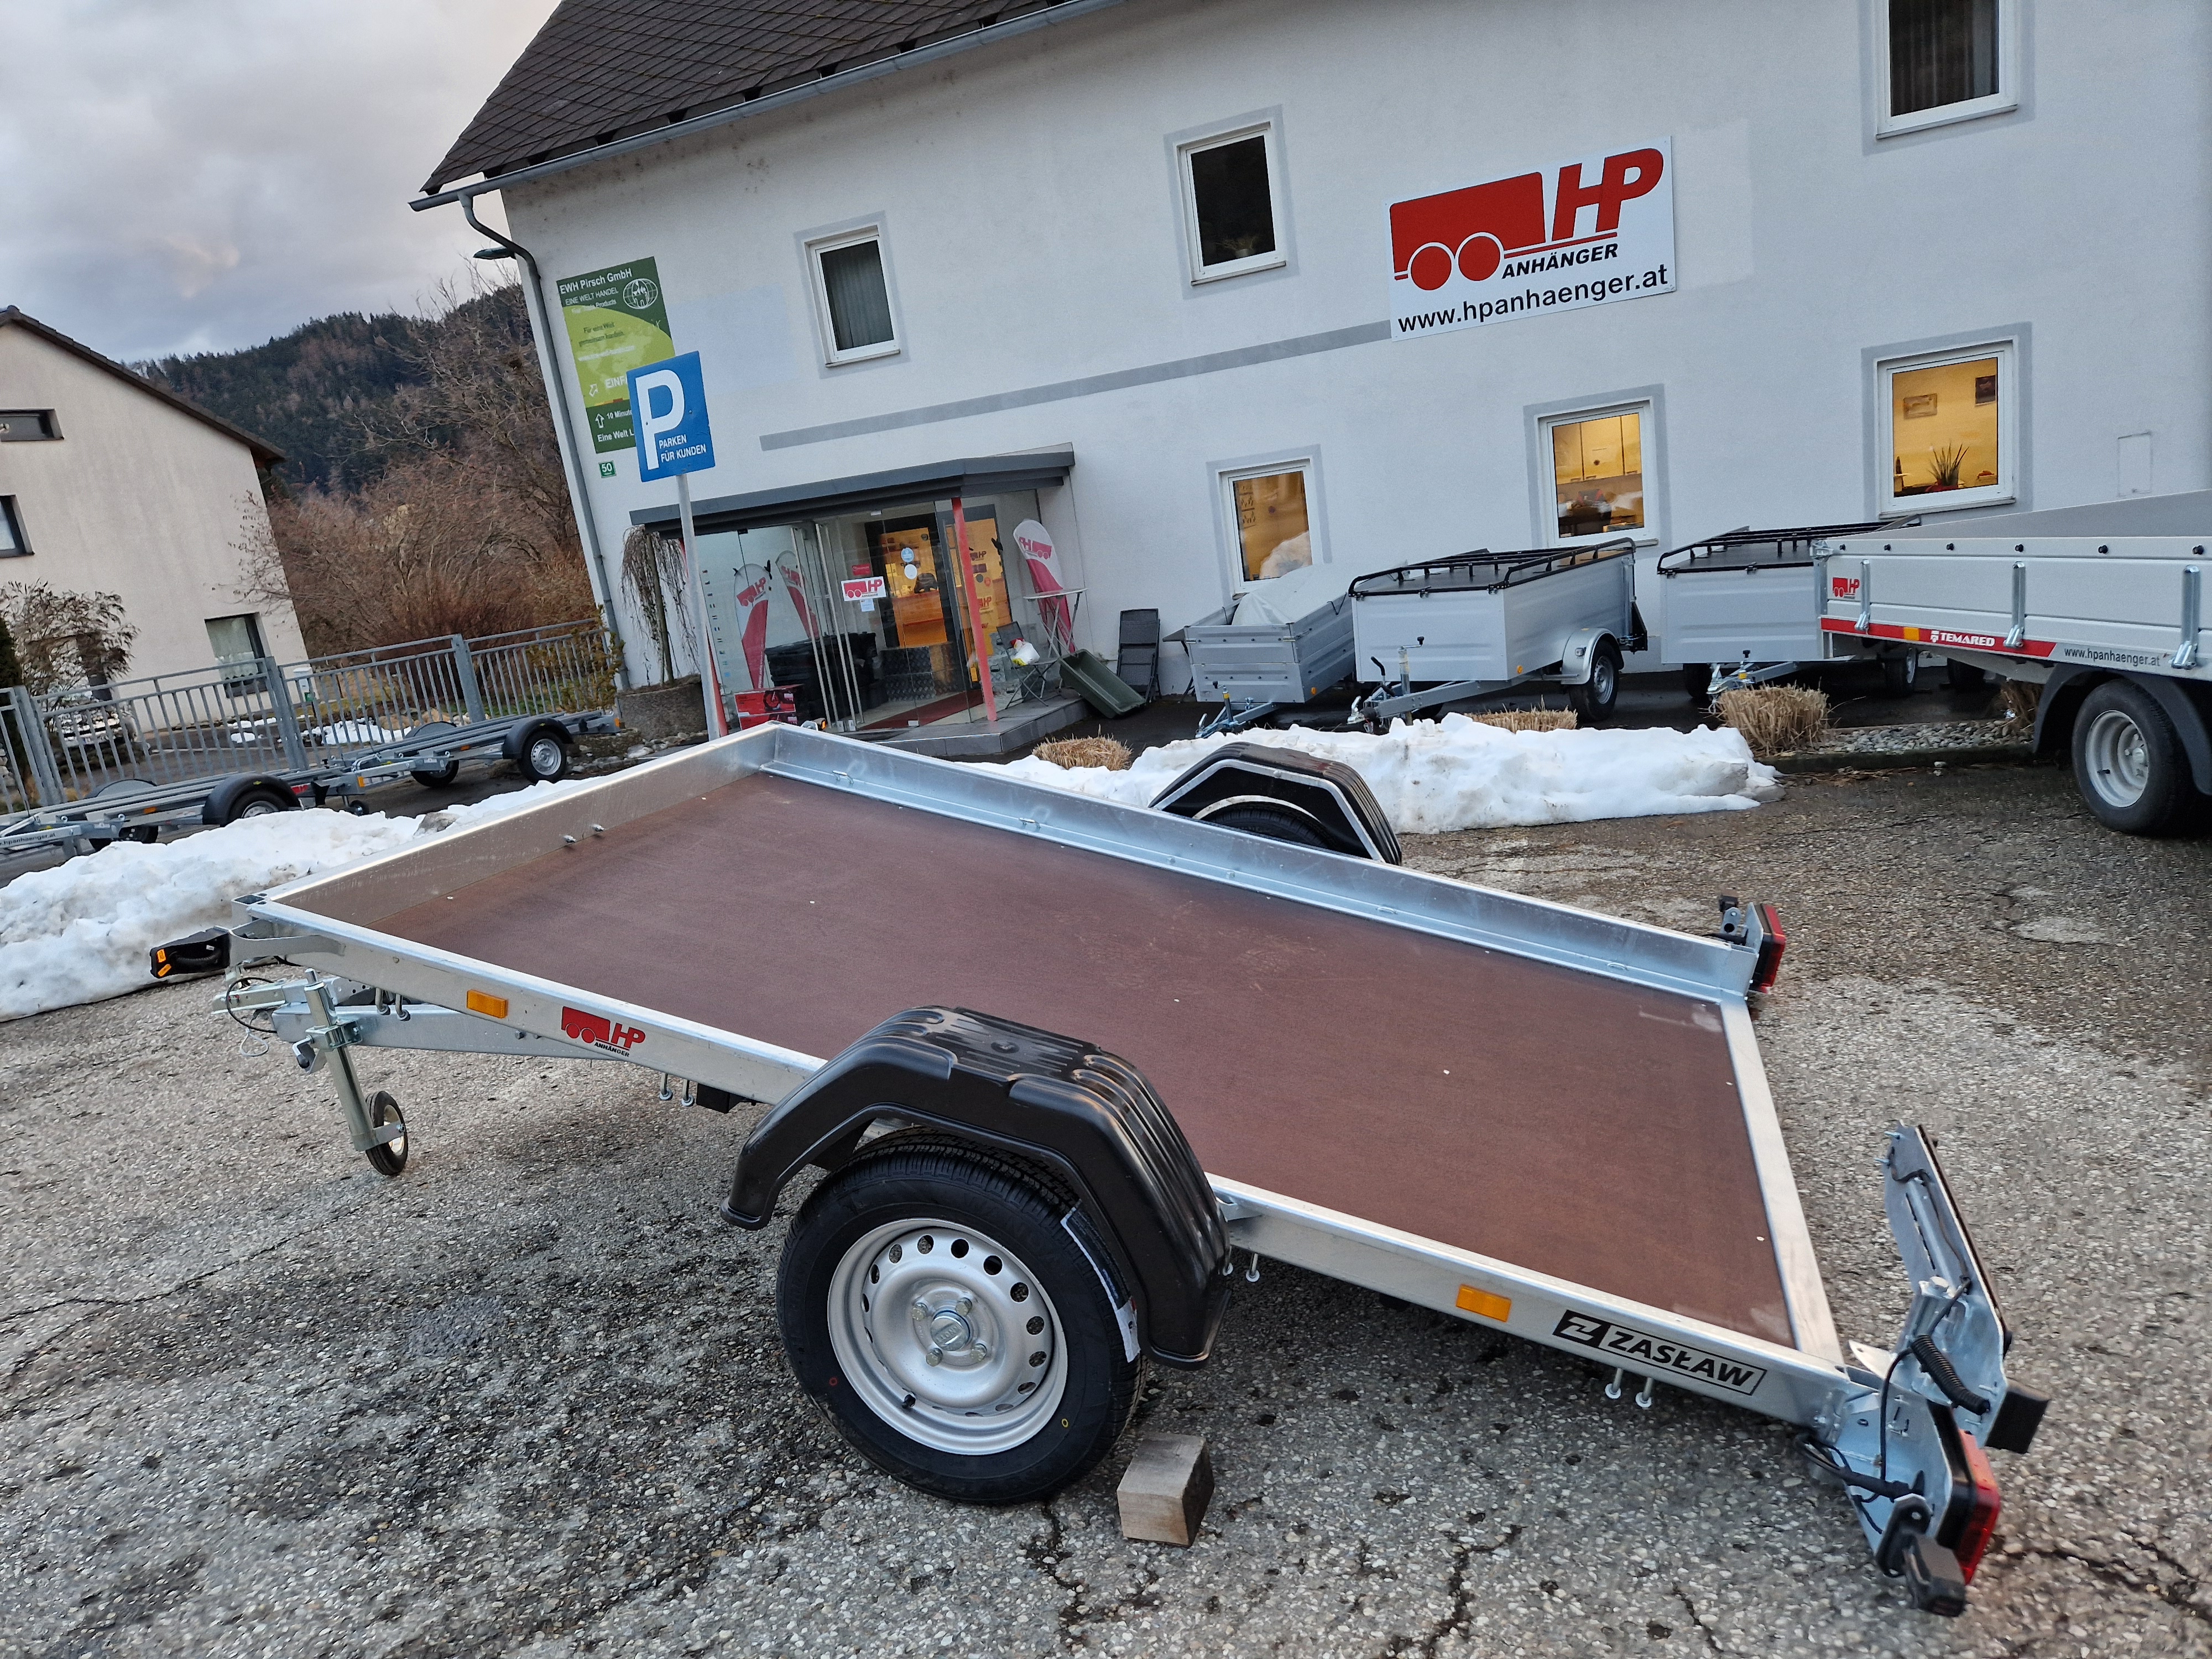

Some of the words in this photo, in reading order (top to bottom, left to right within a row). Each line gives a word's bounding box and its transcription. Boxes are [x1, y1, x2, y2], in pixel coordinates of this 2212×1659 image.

[1552, 148, 1664, 242] HP
[1501, 243, 1619, 279] ANHÄNGER
[559, 281, 579, 295] EWH
[580, 275, 606, 289] Pirsch
[607, 268, 633, 282] GmbH
[565, 297, 579, 305] EINE
[579, 293, 594, 302] WELT
[596, 287, 619, 298] HANDEL
[1399, 264, 1668, 332] www.hpanhaenger.at
[635, 369, 685, 470] P
[597, 434, 612, 442] Eine
[613, 429, 628, 439] Welt
[659, 434, 687, 449] PARKEN
[661, 450, 675, 463] FÜR
[676, 444, 706, 458] KUNDEN
[601, 463, 612, 472] 50
[868, 579, 883, 592] HP
[1849, 578, 1860, 593] HP
[1940, 633, 1995, 647] TEMARED
[2064, 648, 2161, 666] www.hpanhaenger.at
[611, 1022, 645, 1048] HP
[594, 1042, 630, 1057] ANHÄNGER
[1608, 1331, 1755, 1387] ZASŁAW
